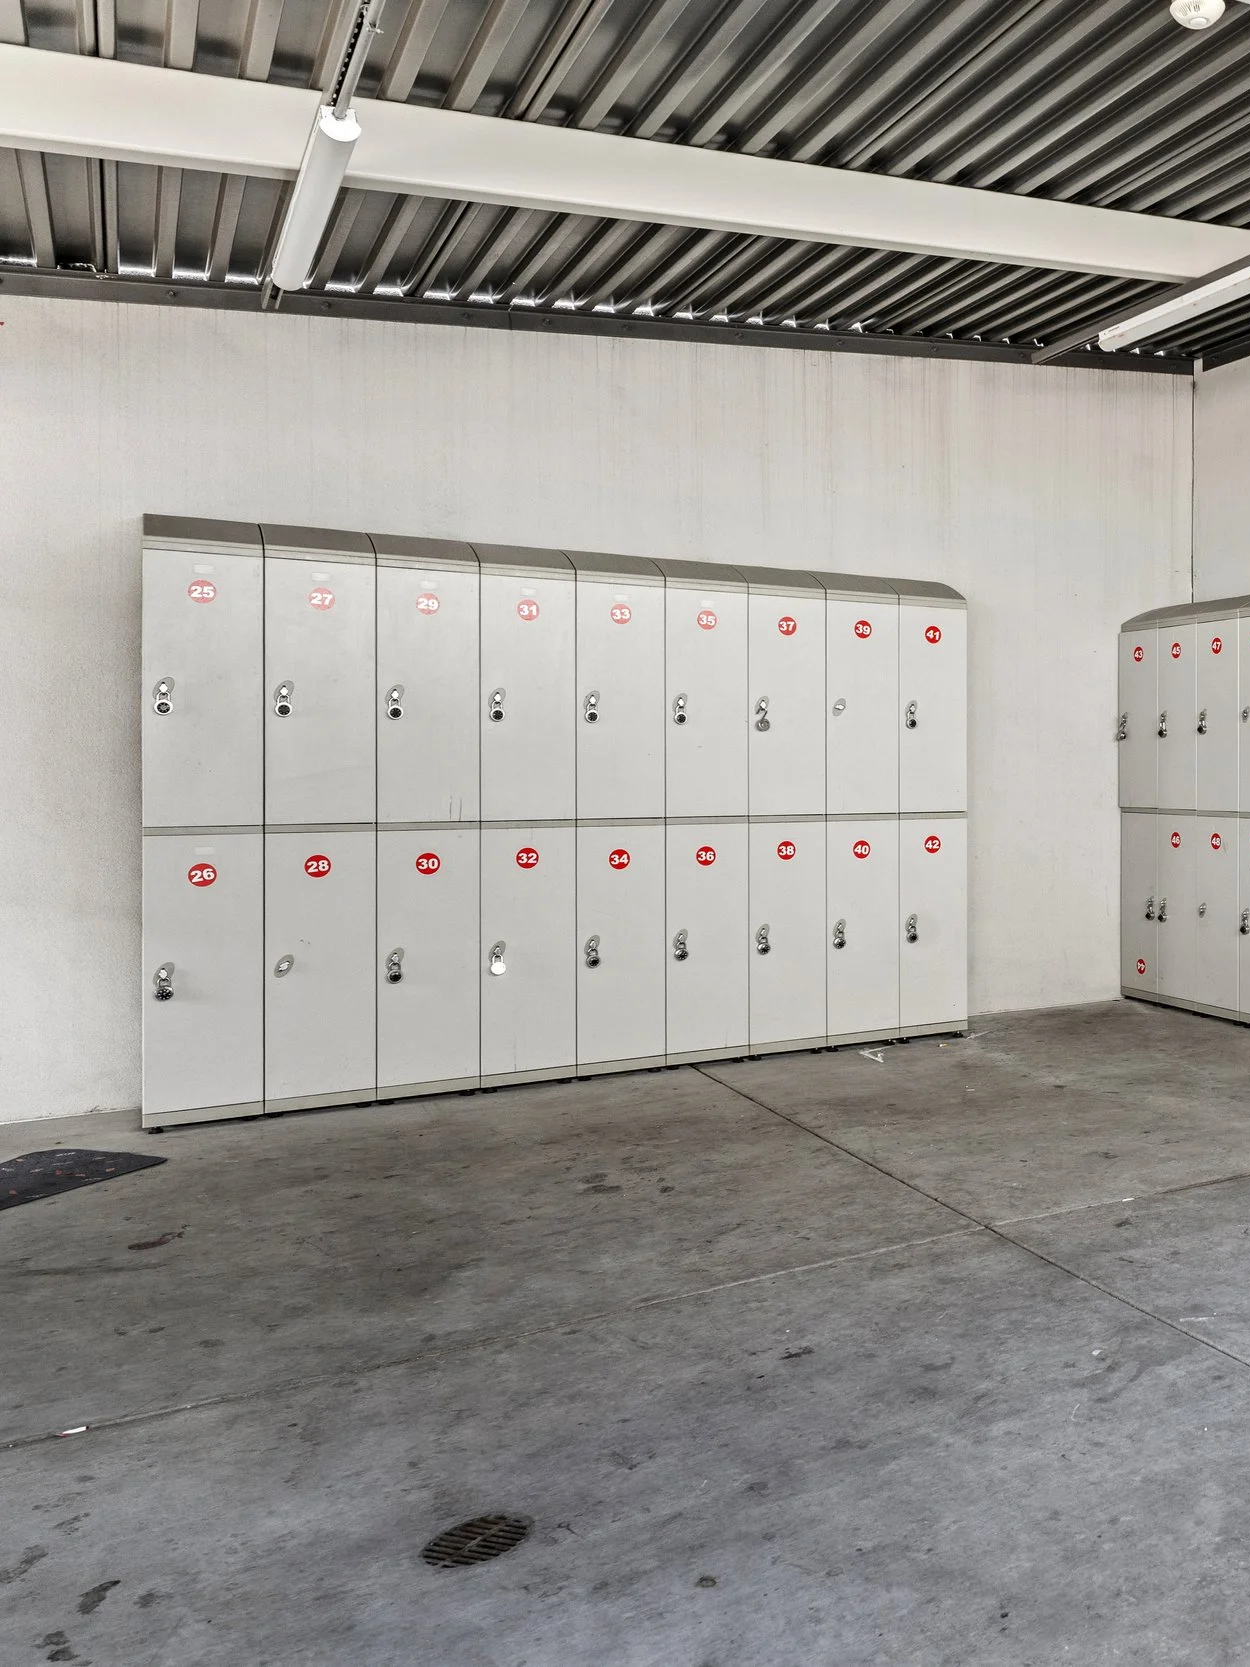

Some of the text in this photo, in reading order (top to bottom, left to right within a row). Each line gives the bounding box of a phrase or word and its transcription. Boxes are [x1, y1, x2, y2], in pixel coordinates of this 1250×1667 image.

[190, 585, 215, 599] 25
[310, 592, 334, 606] 27
[417, 597, 439, 611] 29
[519, 604, 538, 616] 31
[611, 608, 631, 620] 33
[698, 613, 716, 626] 35
[778, 620, 796, 632] 37
[855, 623, 871, 636] 39
[925, 629, 940, 641] 41
[1170, 645, 1182, 656] 45
[1211, 640, 1223, 651] 47
[1133, 649, 1144, 659] 43
[924, 839, 940, 850] 42
[1170, 835, 1181, 845] 46
[1210, 836, 1222, 847] 48
[778, 845, 795, 856] 38
[853, 844, 870, 855] 40
[517, 852, 538, 864] 32
[610, 853, 629, 866] 34
[697, 850, 715, 862] 36
[306, 859, 330, 874] 28
[417, 857, 439, 870] 30
[190, 867, 216, 883] 26
